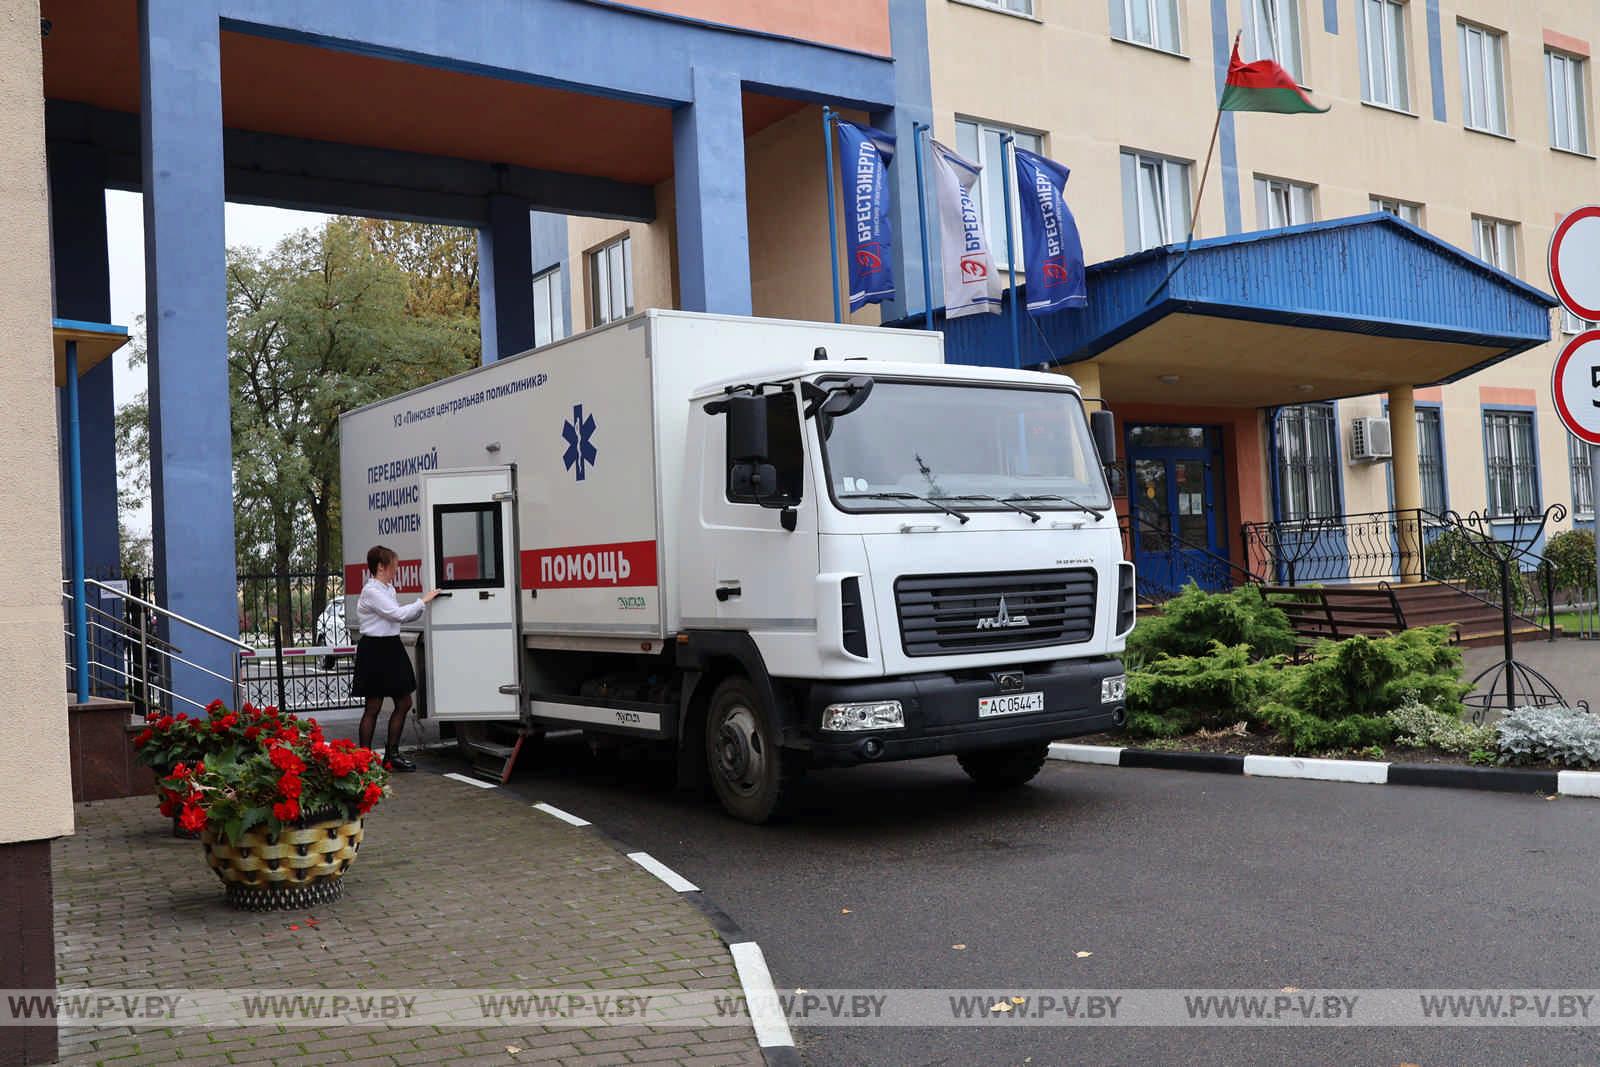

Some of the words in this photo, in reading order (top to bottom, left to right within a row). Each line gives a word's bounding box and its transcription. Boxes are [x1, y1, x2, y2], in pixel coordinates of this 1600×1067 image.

[856, 141, 875, 242] БРЕСТЭНЕРГО
[1035, 165, 1060, 257] БРЕСТЭНЕРГ
[393, 413, 403, 427] УЗ
[436, 391, 485, 415] центральная
[486, 372, 548, 400] поликлиника»
[367, 446, 438, 485] ПЕРЕДВИЖНОЙ
[368, 484, 419, 512] МЕДИЦИНС
[378, 512, 421, 536] КОМПЛЕК
[541, 550, 631, 584] ПОМОЩЬ
